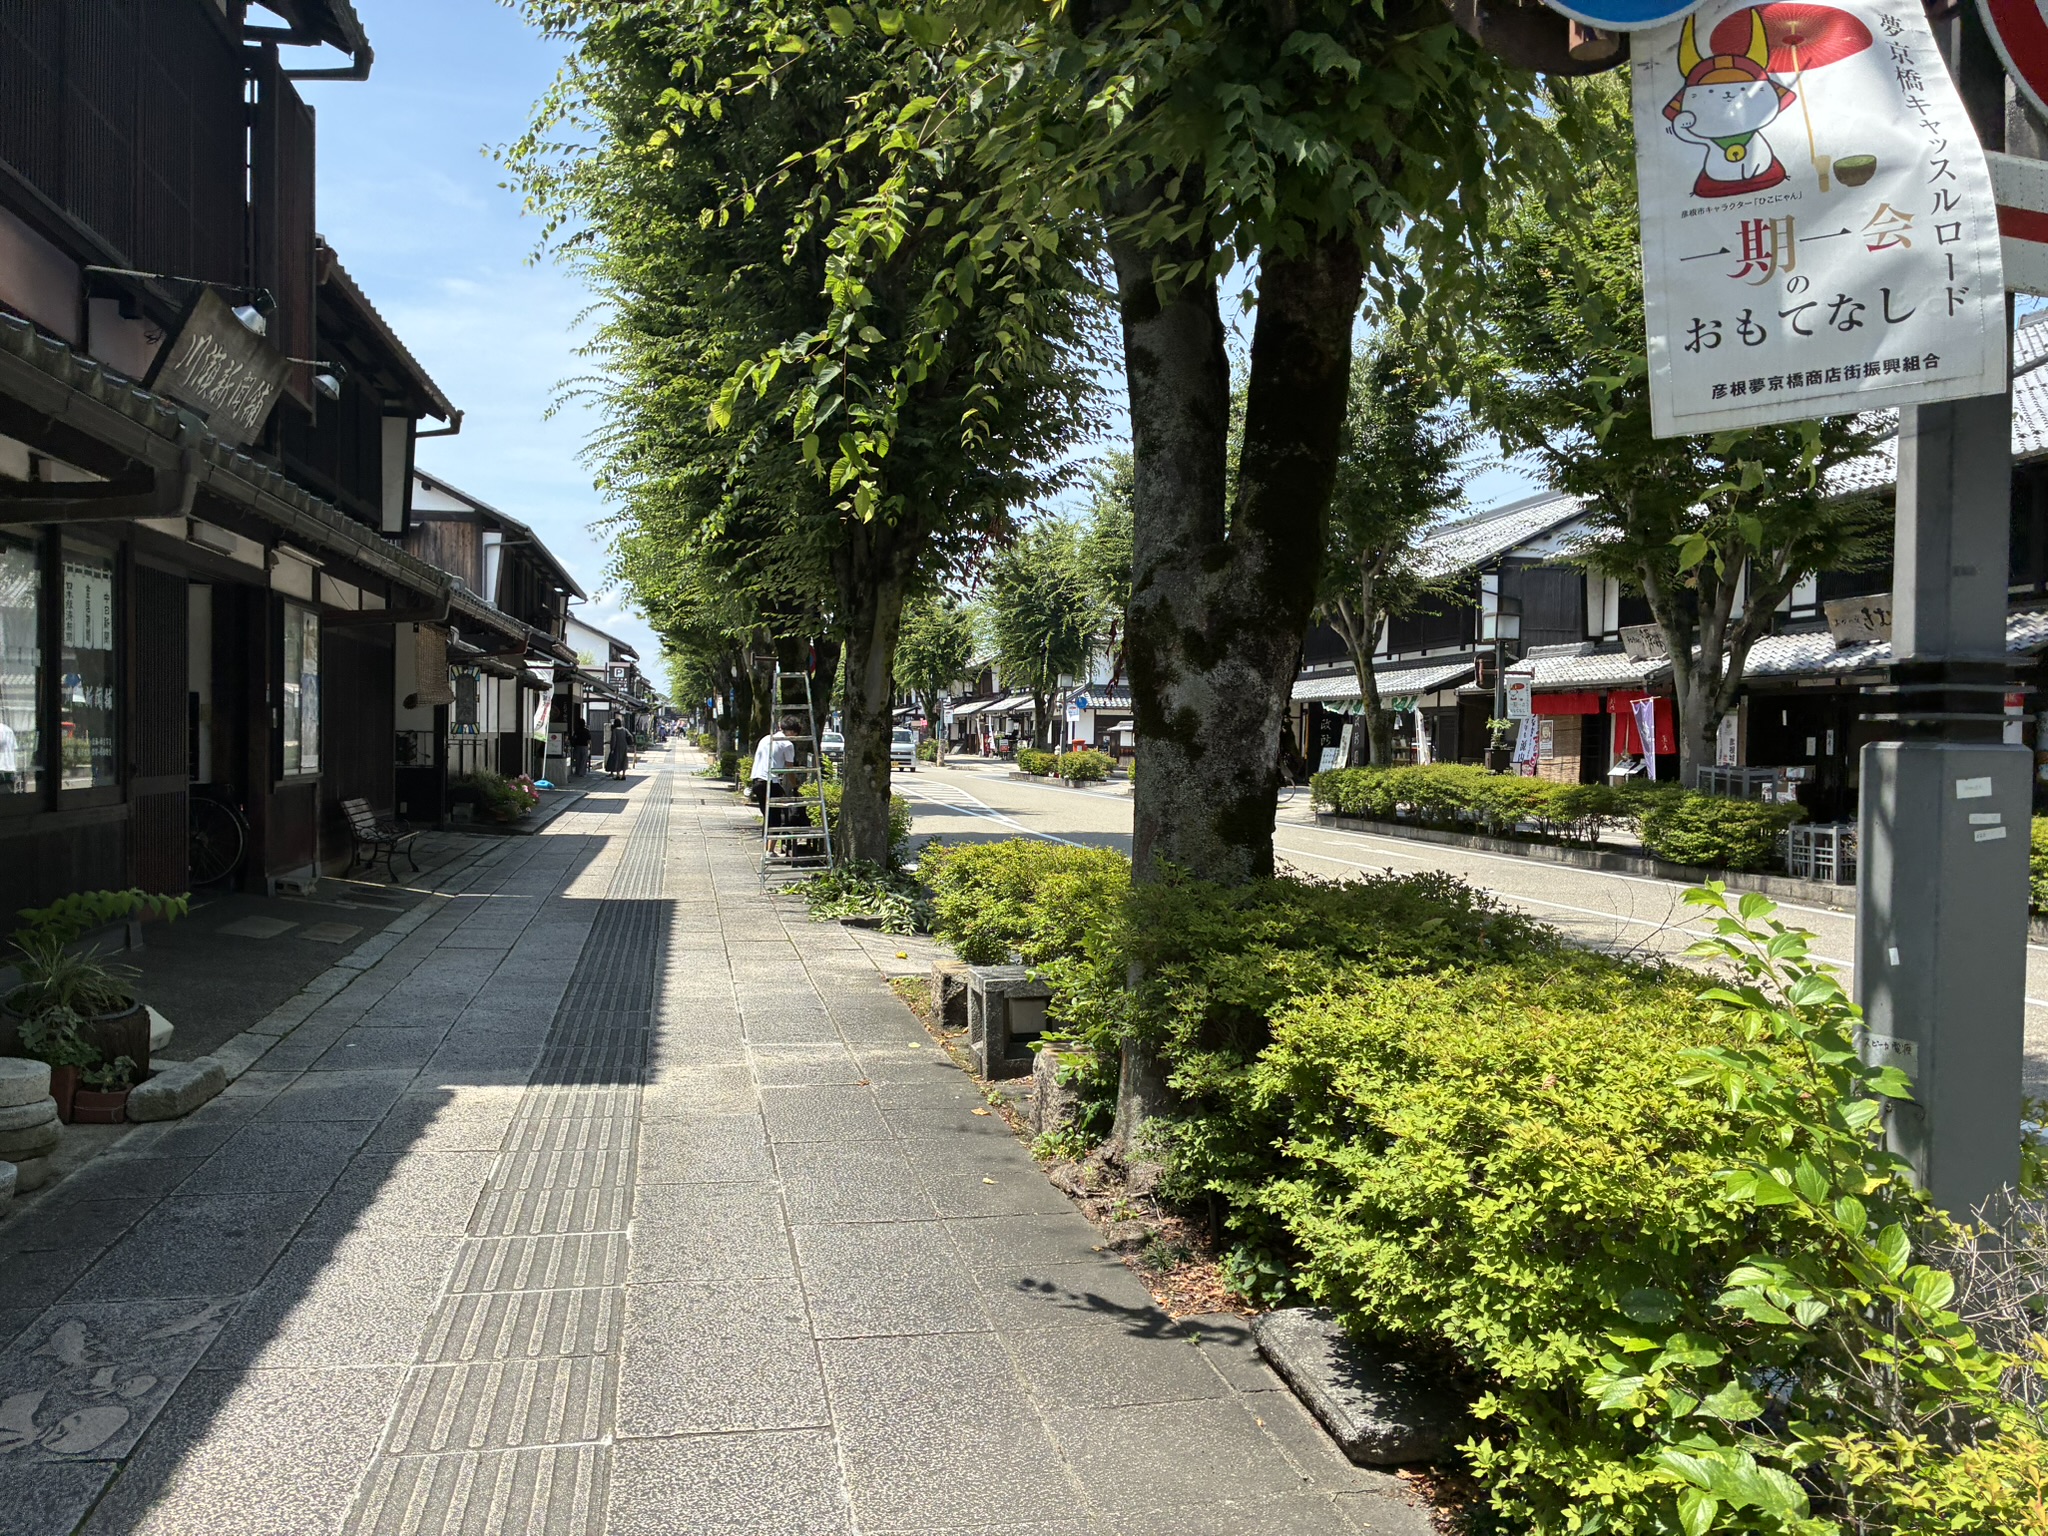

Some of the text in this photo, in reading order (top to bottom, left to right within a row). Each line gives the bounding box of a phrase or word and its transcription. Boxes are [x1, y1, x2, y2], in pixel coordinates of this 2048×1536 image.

[1879, 13, 1969, 317] 夢京橋キャッスルロード
[1680, 203, 1915, 286] 一期一会
[1786, 275, 1810, 294] の
[1684, 287, 1916, 354] おもてなし
[1711, 352, 1941, 400] 彦根夢京橋商店街振興組合
